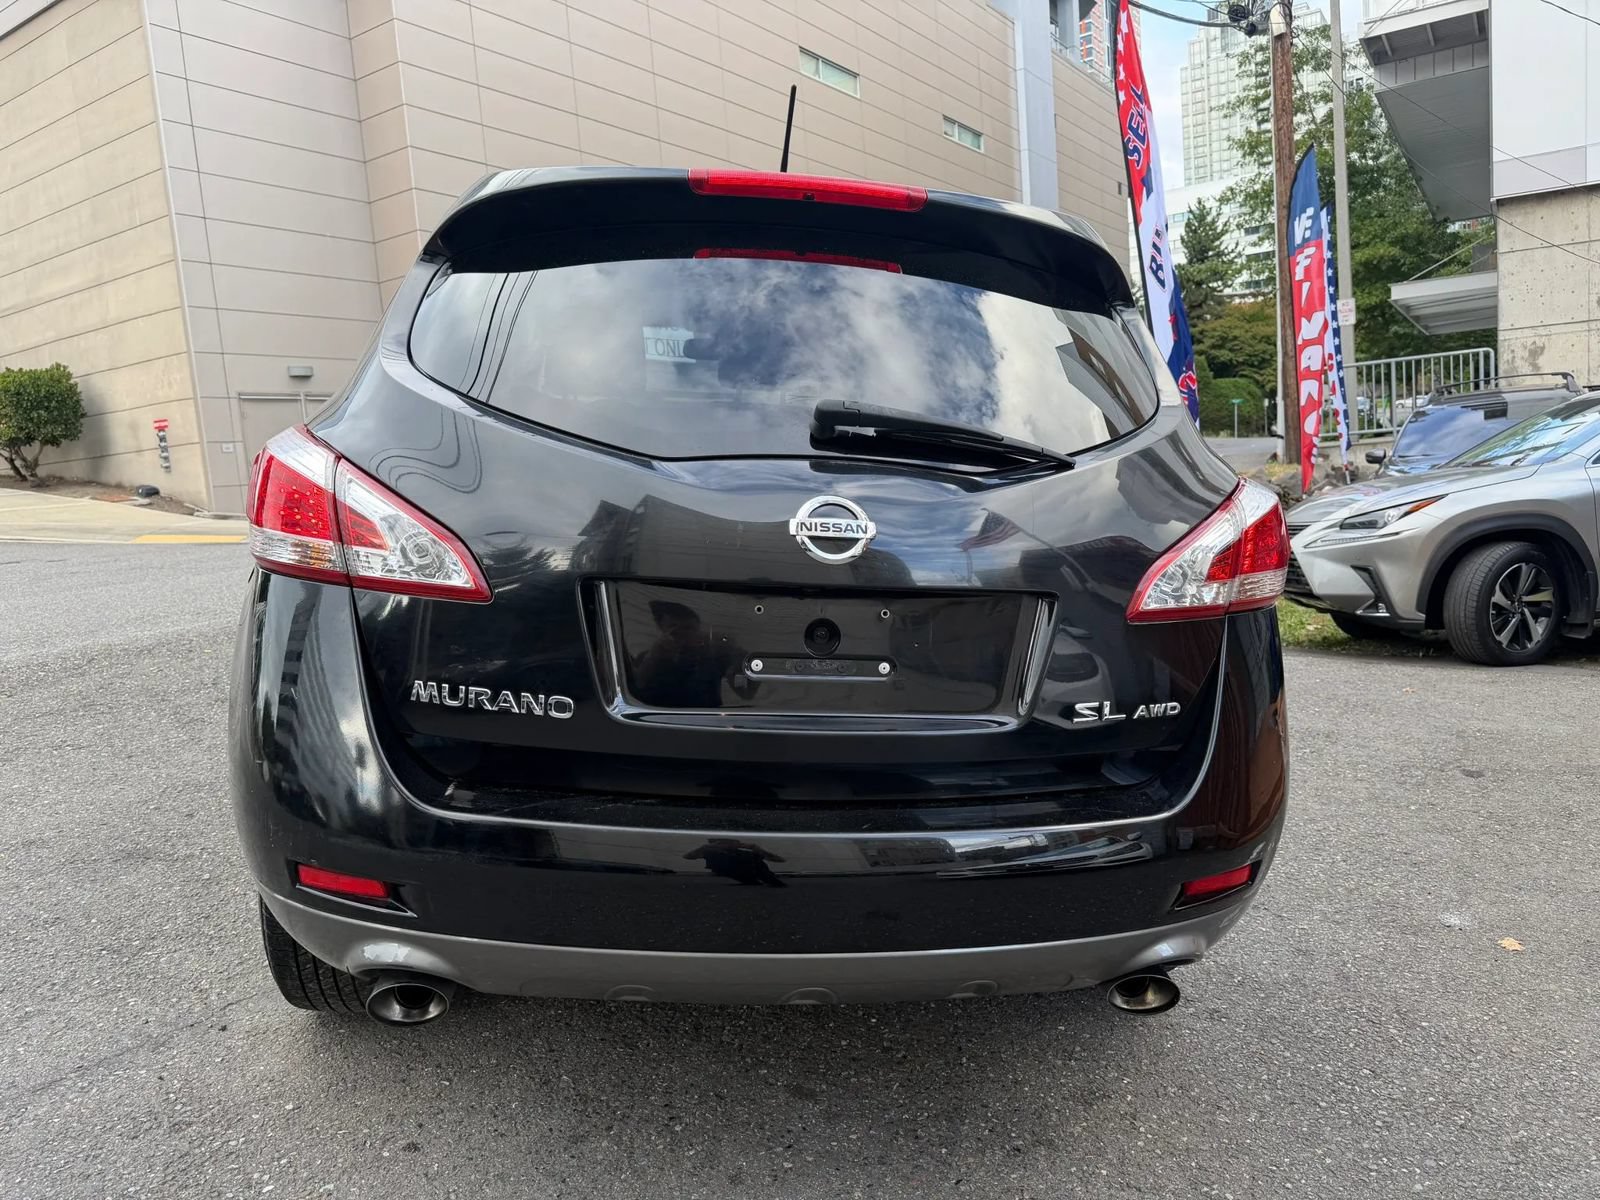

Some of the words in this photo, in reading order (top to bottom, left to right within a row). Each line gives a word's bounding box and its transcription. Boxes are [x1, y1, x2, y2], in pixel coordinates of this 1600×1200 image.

[799, 521, 868, 535] NISSAN
[410, 680, 574, 719] MURANO
[1072, 701, 1127, 723] SL
[1132, 702, 1181, 719] AWD
